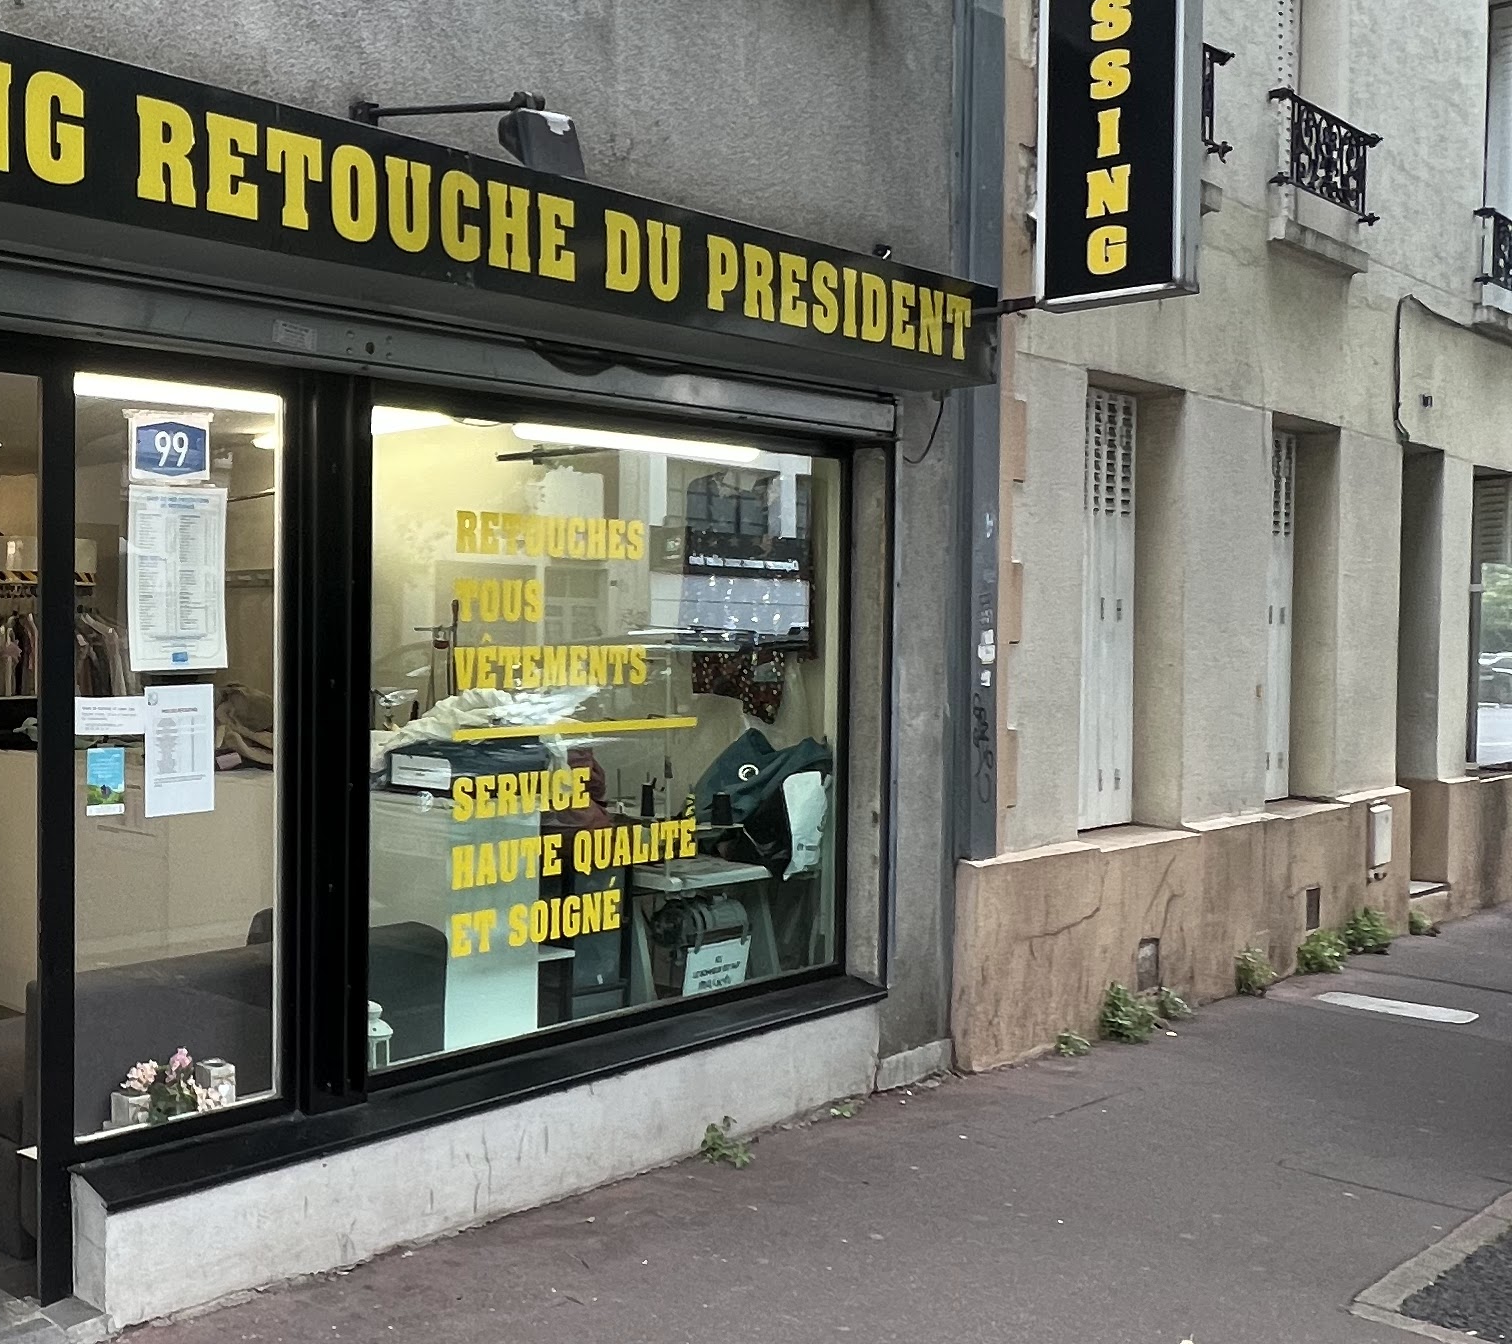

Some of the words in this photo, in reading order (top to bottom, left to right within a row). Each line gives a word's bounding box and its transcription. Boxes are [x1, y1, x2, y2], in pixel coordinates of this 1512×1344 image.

[135, 94, 575, 283] RETOUCHE
[605, 209, 681, 303] DU
[707, 235, 972, 362] PRESIDENT
[154, 430, 189, 467] 99
[455, 509, 645, 562] RETOUCHES
[454, 578, 545, 623] TOUS
[453, 632, 648, 691] VÊTEMENTS
[451, 766, 591, 822] SERVICE
[451, 832, 563, 891] HAUTE
[450, 908, 498, 958] ET
[507, 876, 622, 947] SOIGNÉ
